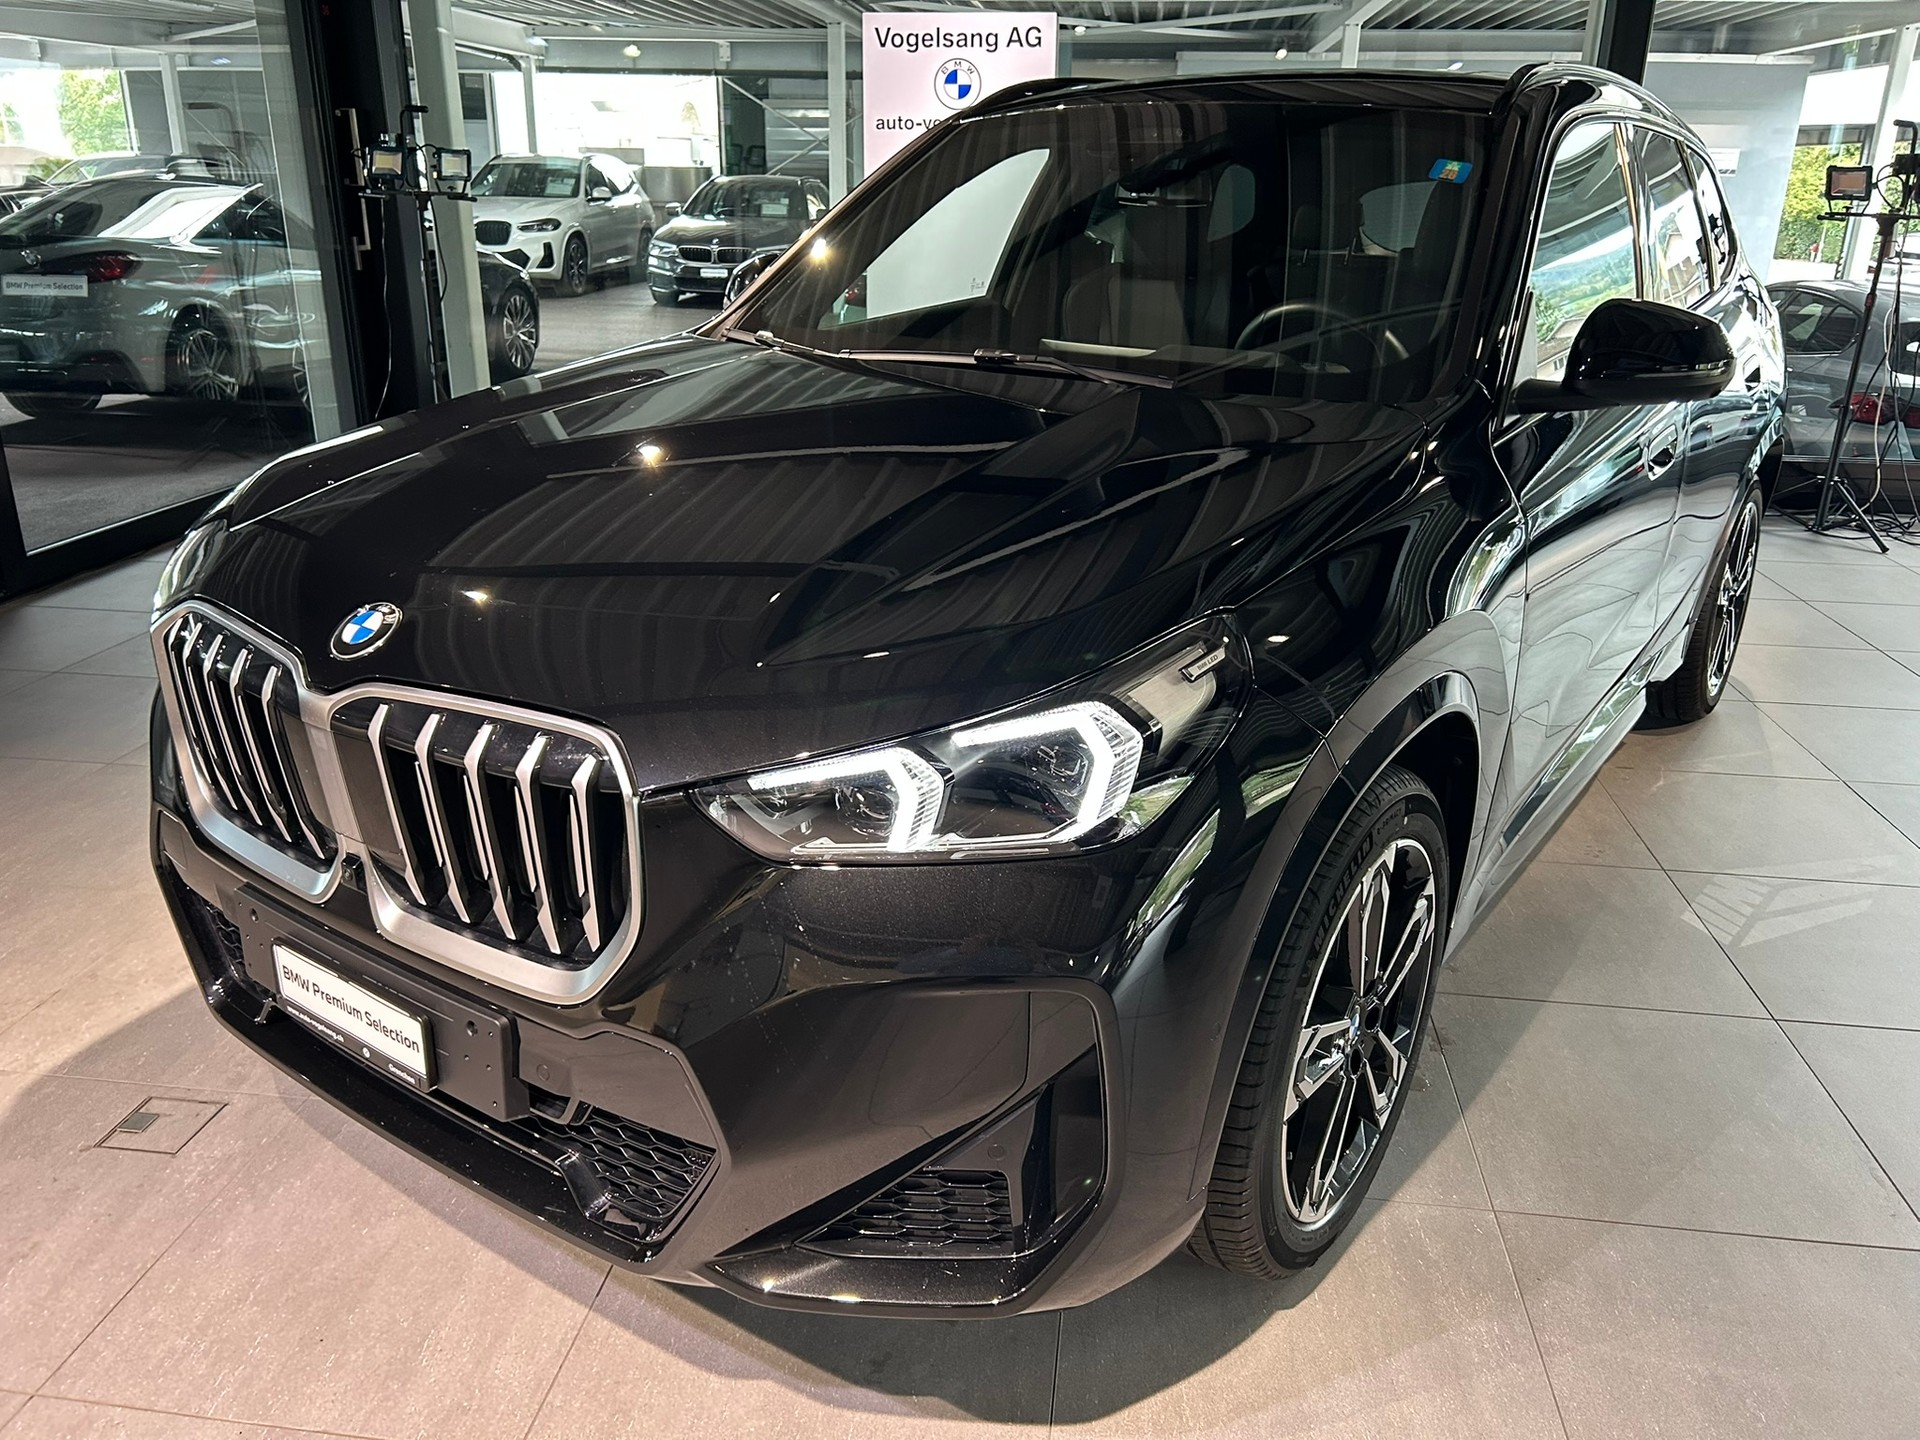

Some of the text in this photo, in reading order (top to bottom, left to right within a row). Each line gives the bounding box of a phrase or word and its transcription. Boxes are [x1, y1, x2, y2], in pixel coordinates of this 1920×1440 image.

[874, 26, 1042, 53] Vogelsang AG
[940, 60, 975, 75] BMW
[5, 281, 22, 289] BMW
[53, 282, 84, 290] Selection
[1313, 831, 1374, 951] MICHELIN
[282, 964, 420, 1054] BMW Premium Selection
